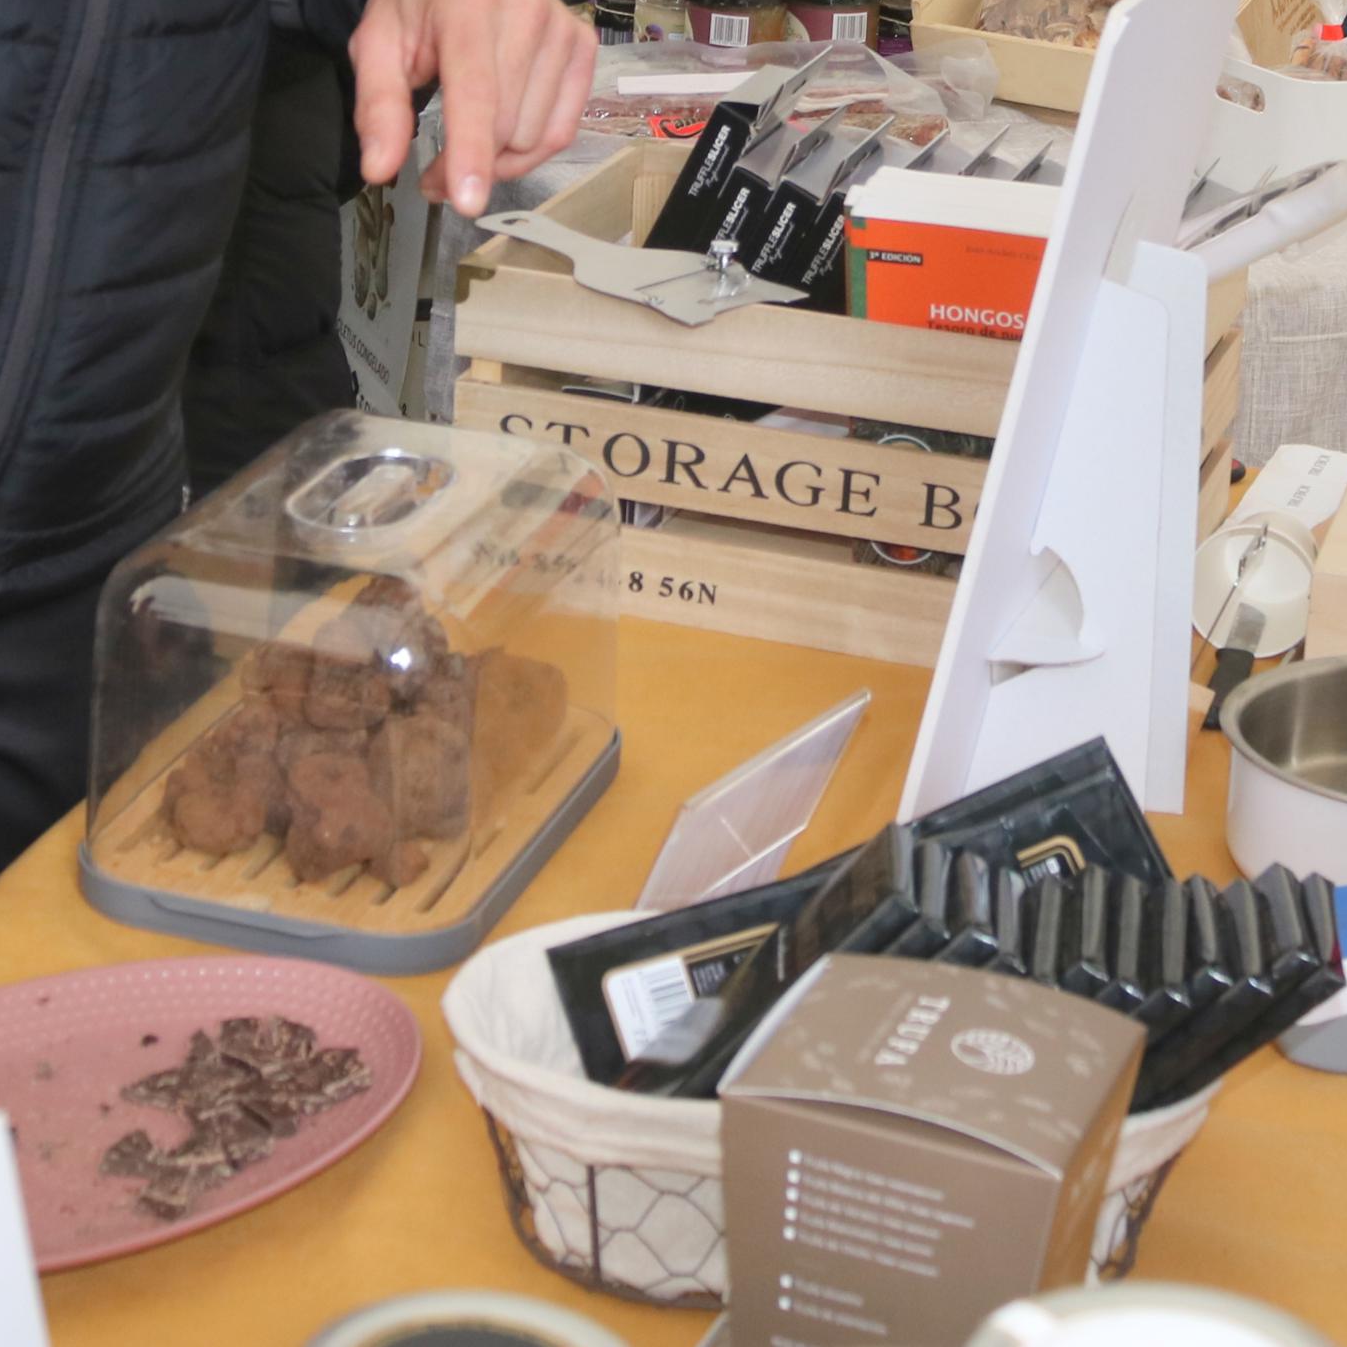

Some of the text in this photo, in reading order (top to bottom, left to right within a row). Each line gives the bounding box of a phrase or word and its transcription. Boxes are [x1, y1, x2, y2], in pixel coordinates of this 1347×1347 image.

[688, 124, 732, 197] TRUFFLESLICER
[751, 201, 797, 274] TRUFFLESLICER
[929, 304, 1025, 329] HONGOS
[919, 482, 978, 531] B
[874, 995, 951, 1066] TRUFA
